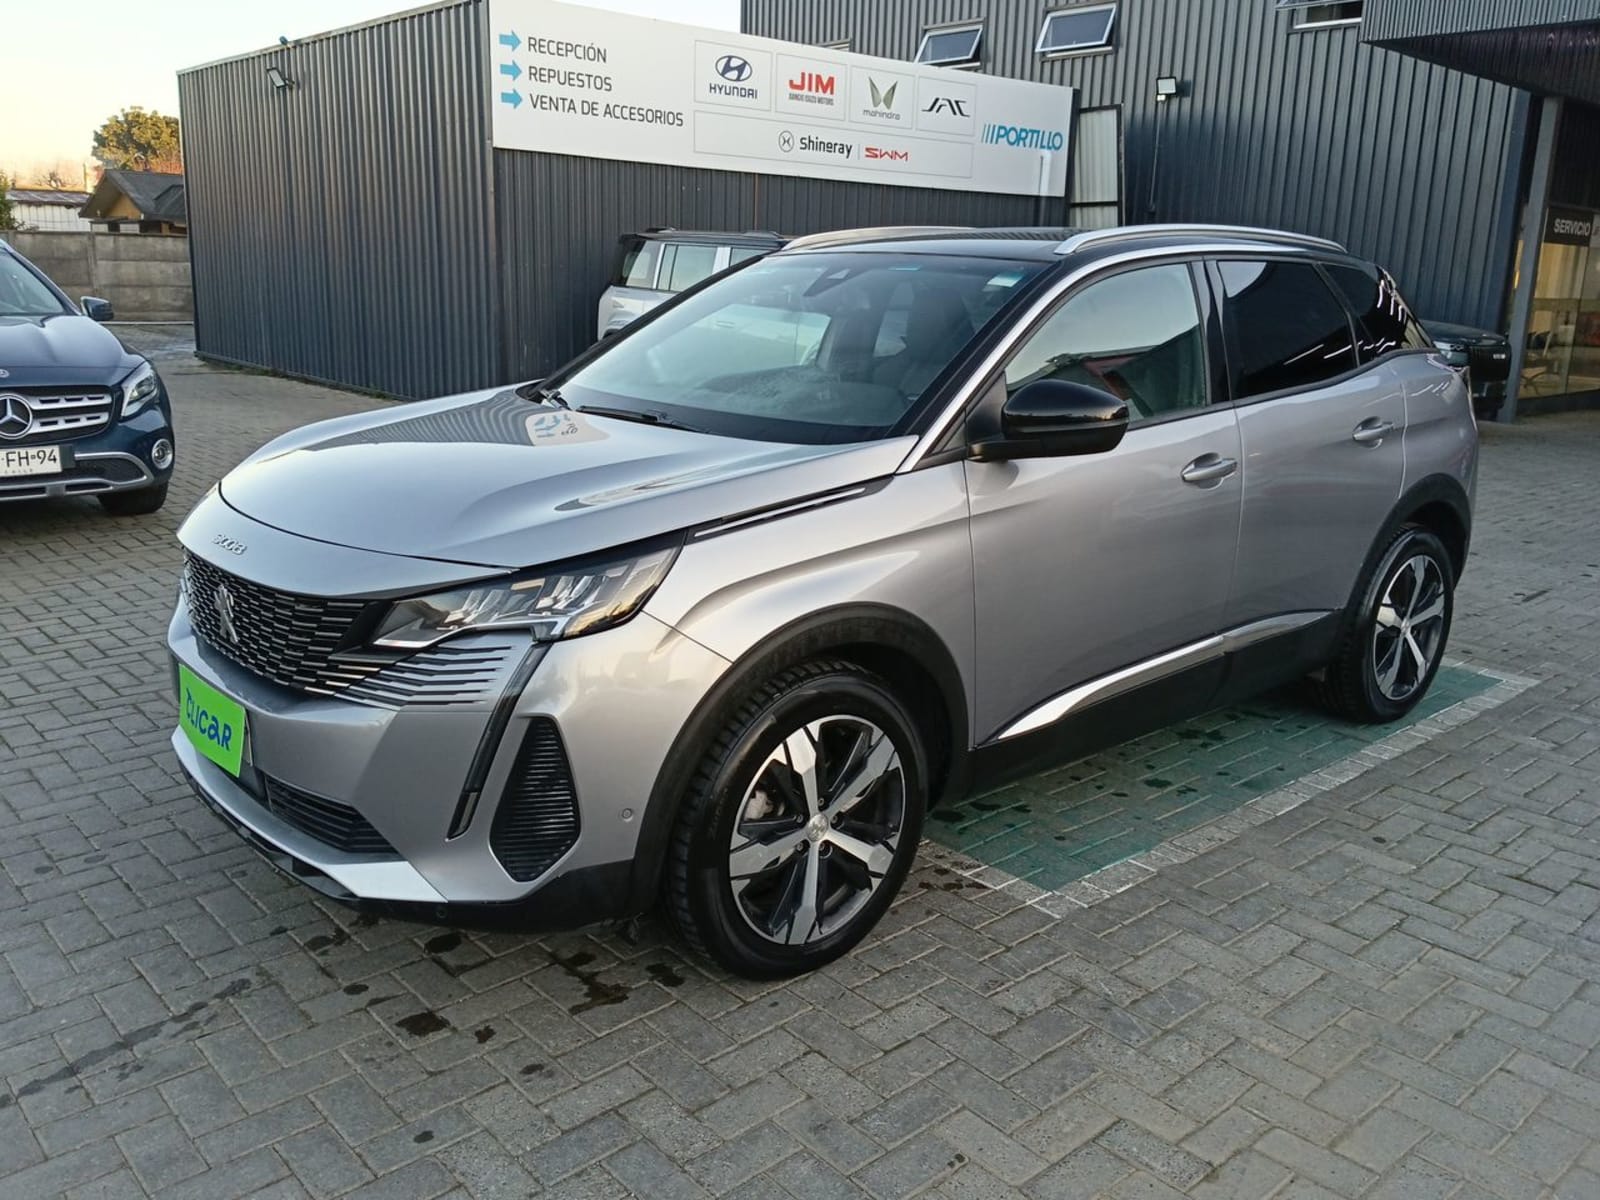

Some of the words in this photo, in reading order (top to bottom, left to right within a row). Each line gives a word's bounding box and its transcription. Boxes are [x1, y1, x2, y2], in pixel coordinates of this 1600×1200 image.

[528, 36, 607, 63] RECEPCIÓN
[528, 65, 612, 92] REPUESTOS
[709, 83, 758, 99] HYUNDAI
[789, 72, 835, 95] JIM
[529, 93, 577, 114] VENTA
[581, 100, 599, 116] DE
[603, 103, 684, 127] ACCESORIOS
[863, 109, 901, 121] mahindra
[922, 97, 970, 118] JAC
[800, 136, 852, 159] Shineray
[865, 147, 908, 162] SWM
[995, 125, 1063, 150] PORTILLO
